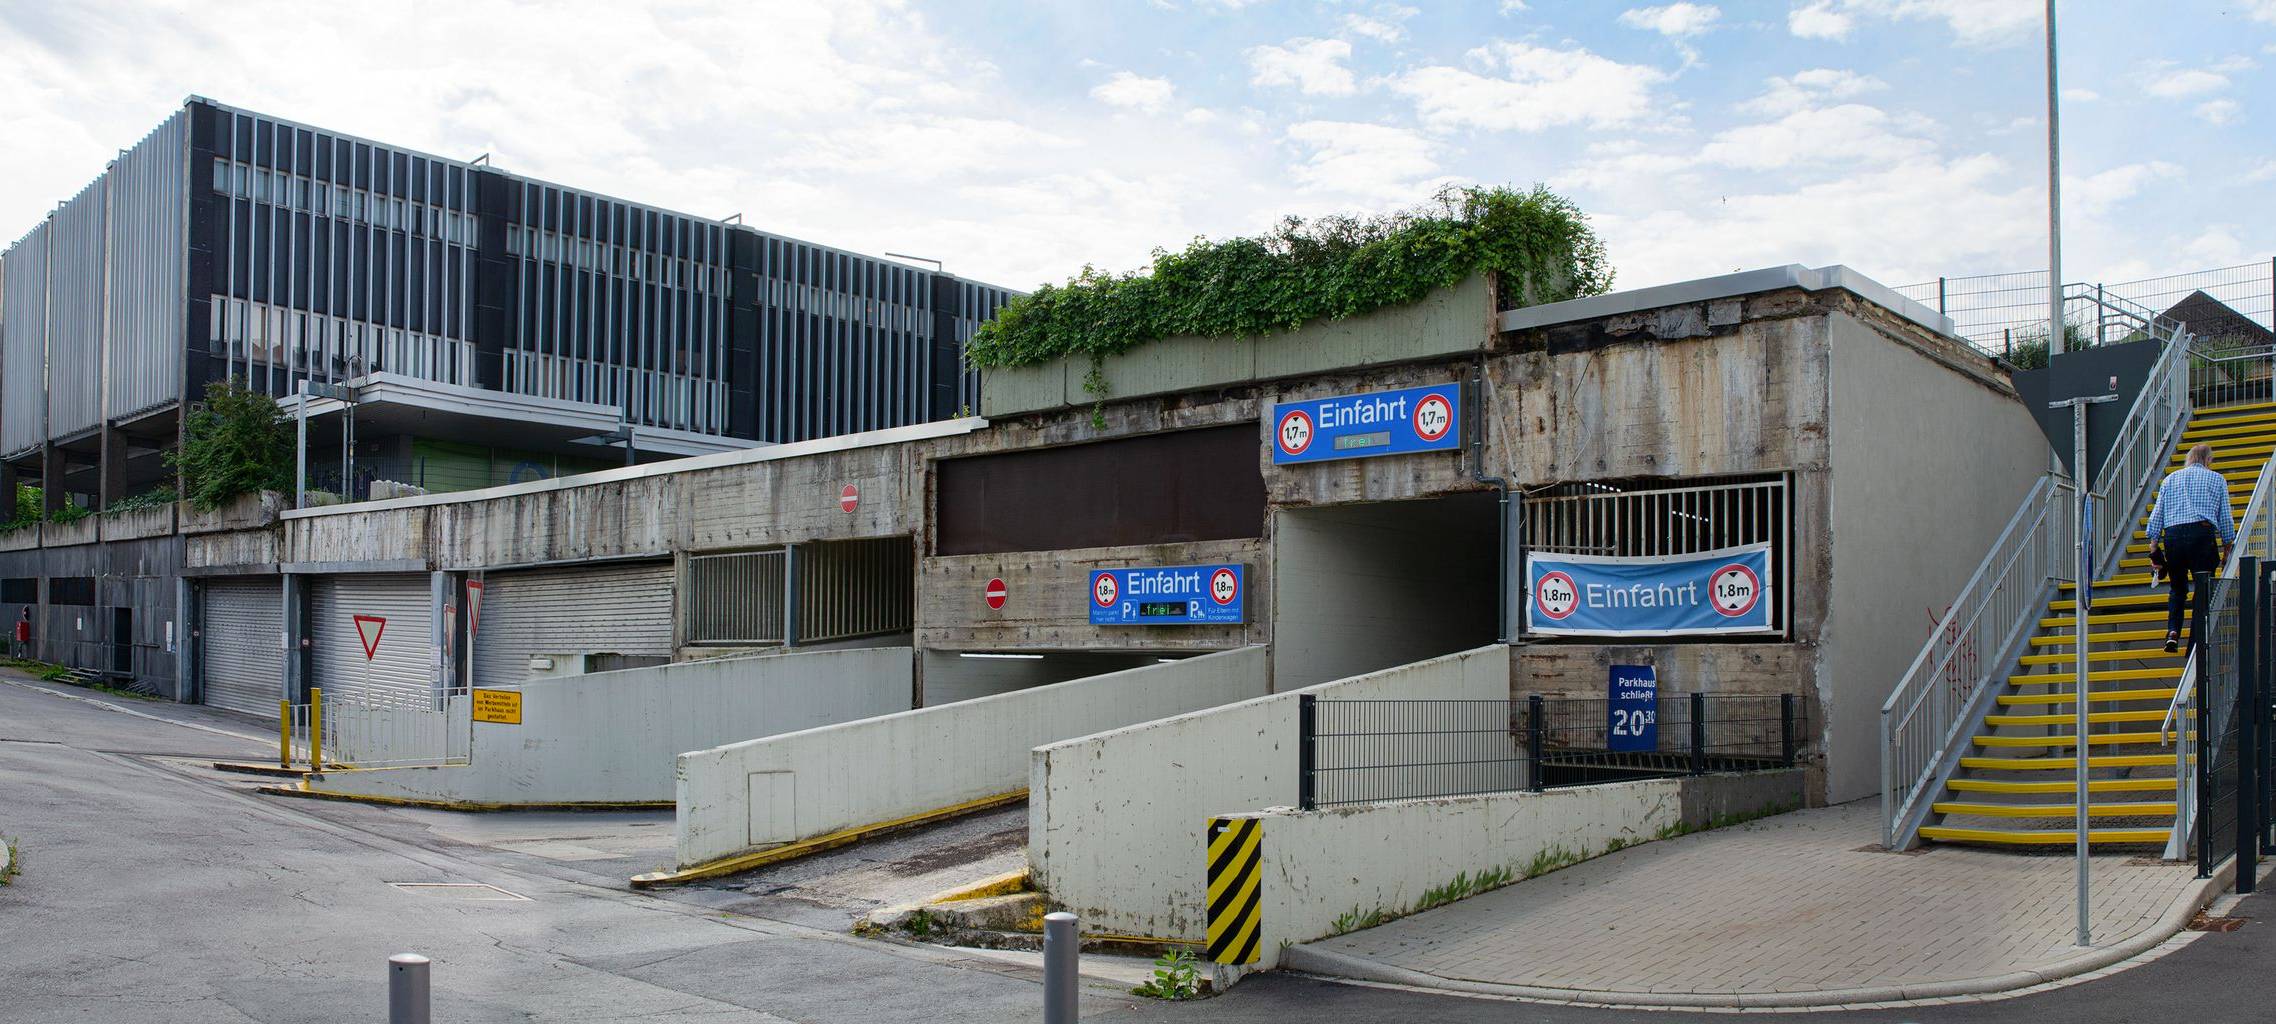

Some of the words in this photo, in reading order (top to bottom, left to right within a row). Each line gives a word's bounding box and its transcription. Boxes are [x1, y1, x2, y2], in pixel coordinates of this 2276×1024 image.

[1319, 395, 1407, 429] Einfahrt
[1127, 570, 1201, 595] Einfahrt
[1586, 580, 1698, 609] Einfahrt
[1146, 603, 1171, 615] frei
[1618, 677, 1656, 688] Parkhaus
[1613, 709, 1645, 737] 20
